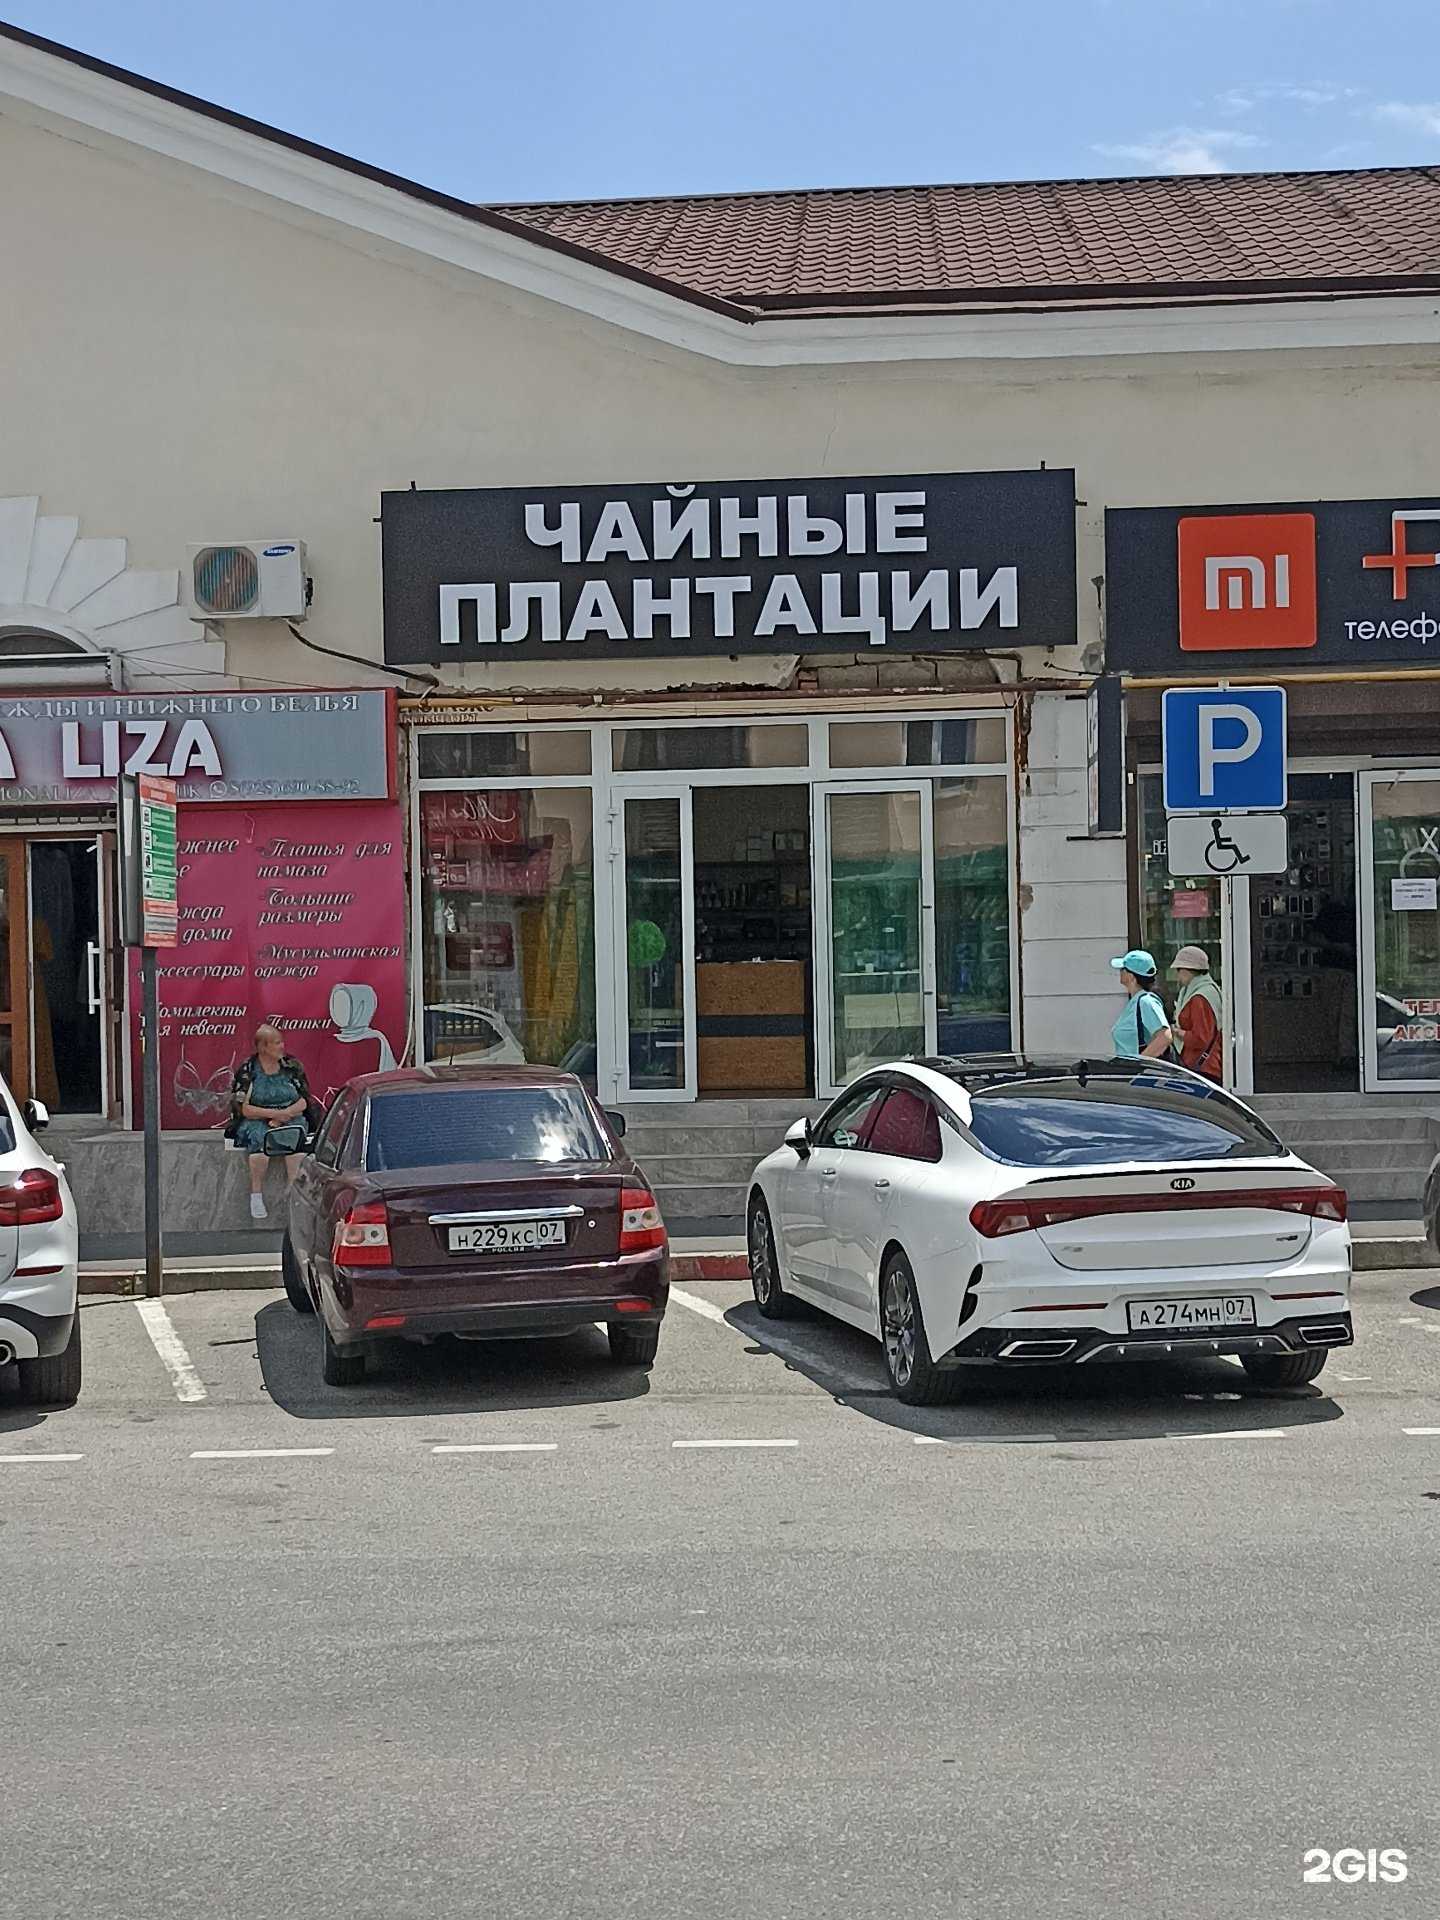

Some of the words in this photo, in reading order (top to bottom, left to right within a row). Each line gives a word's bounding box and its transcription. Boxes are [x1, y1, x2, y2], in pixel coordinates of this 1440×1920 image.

[524, 484, 928, 563] ЧАЙНЫЕ
[439, 566, 1019, 645] ПЛАНТАЦИИ
[1344, 611, 1440, 645] телеф
[87, 700, 105, 716] И
[115, 696, 262, 715] НИЖНЕГО
[270, 694, 360, 713] БЕЛЬЯ
[62, 718, 223, 778] LIZA
[262, 838, 345, 858] Платья
[355, 841, 393, 858] для
[257, 863, 328, 879] намаза
[268, 887, 354, 906] Большие
[258, 909, 344, 926] размеры
[262, 943, 401, 960] Мусульманская
[254, 964, 319, 979] одежда
[181, 1018, 237, 1036] невест
[1173, 1179, 1192, 1189] KIA
